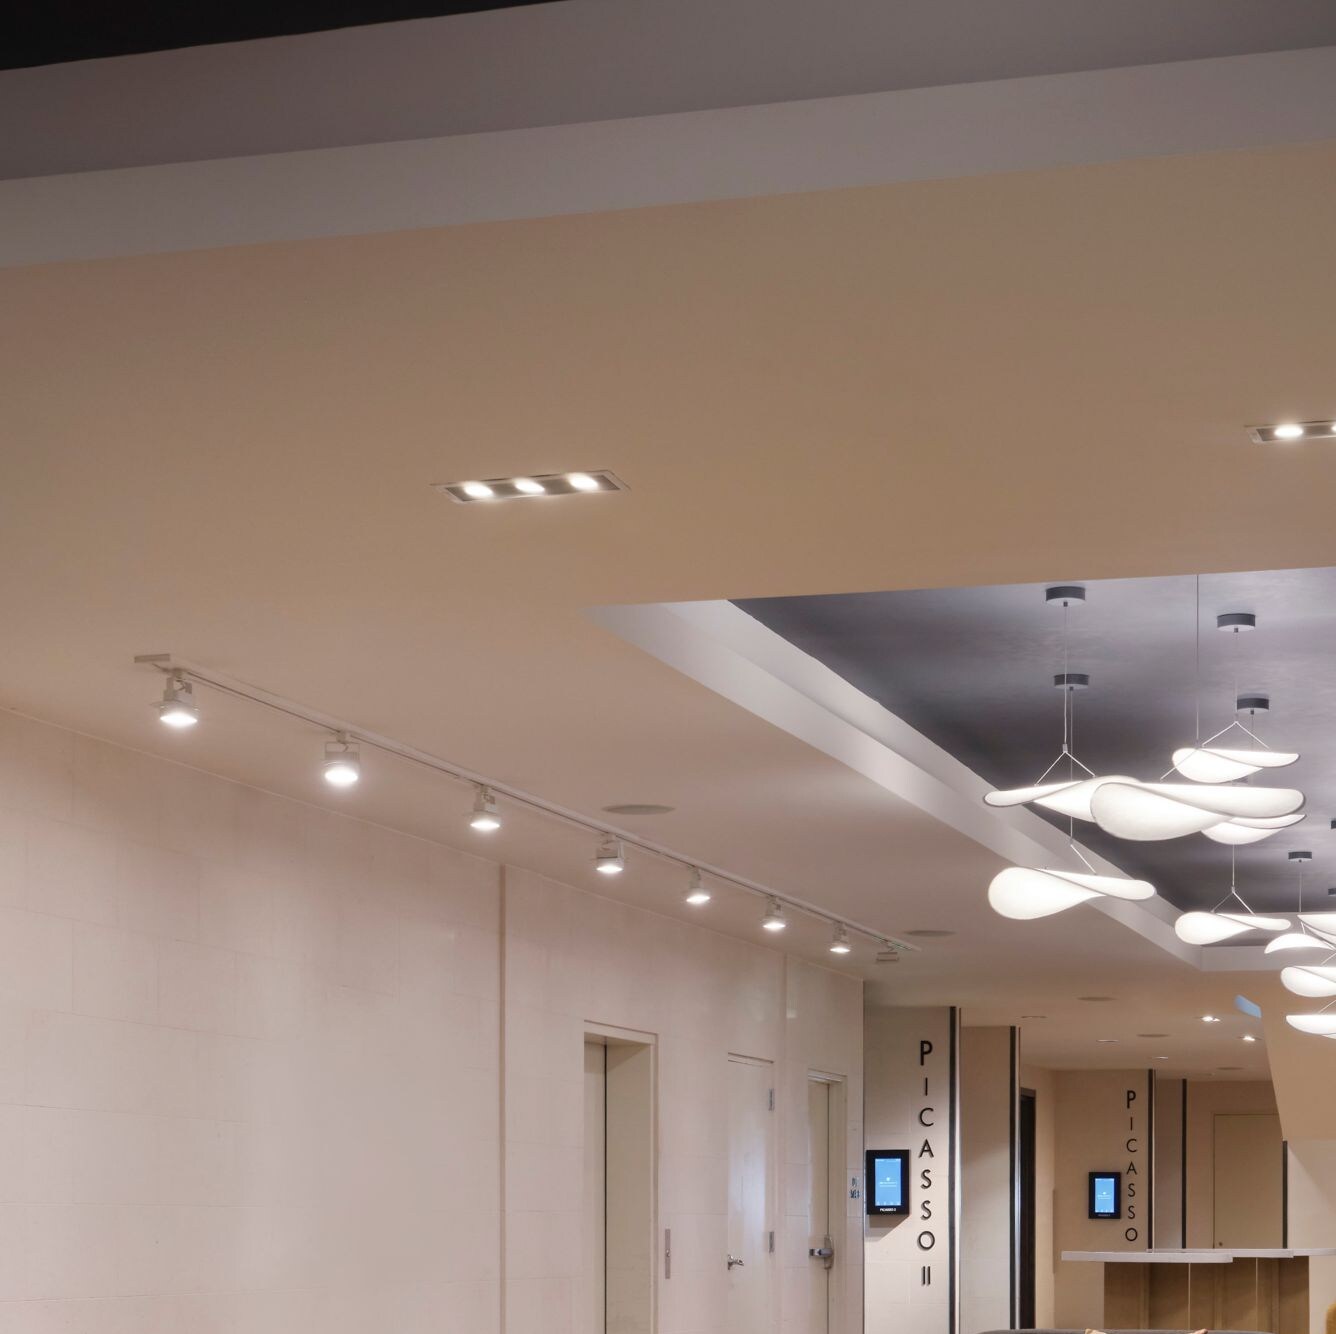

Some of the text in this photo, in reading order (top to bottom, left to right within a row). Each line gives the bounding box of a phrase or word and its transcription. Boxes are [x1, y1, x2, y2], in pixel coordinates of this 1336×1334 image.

[918, 1040, 935, 1286] PICASSO II
[1125, 1090, 1138, 1242] PICASSO
